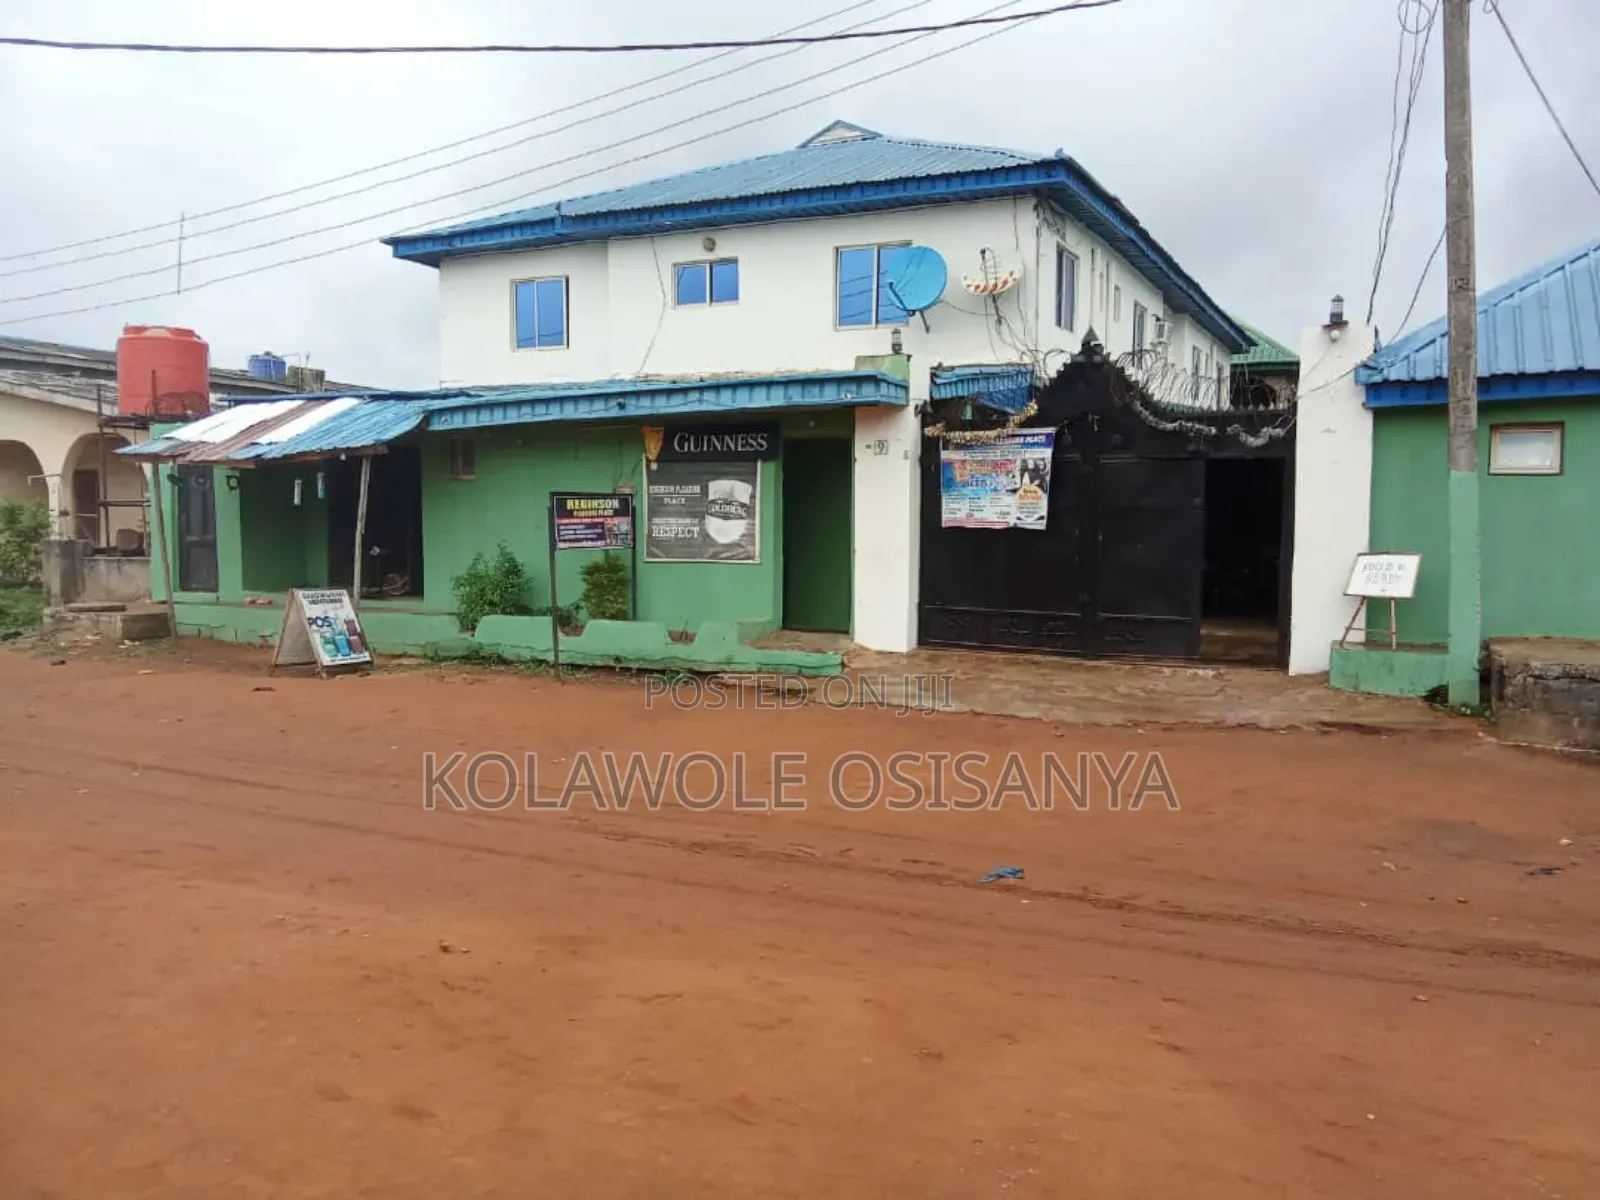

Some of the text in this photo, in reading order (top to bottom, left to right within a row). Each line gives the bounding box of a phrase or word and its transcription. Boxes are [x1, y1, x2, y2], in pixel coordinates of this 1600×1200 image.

[673, 432, 769, 453] GUINNESS
[651, 525, 700, 539] RESPECT
[307, 616, 333, 628] POS
